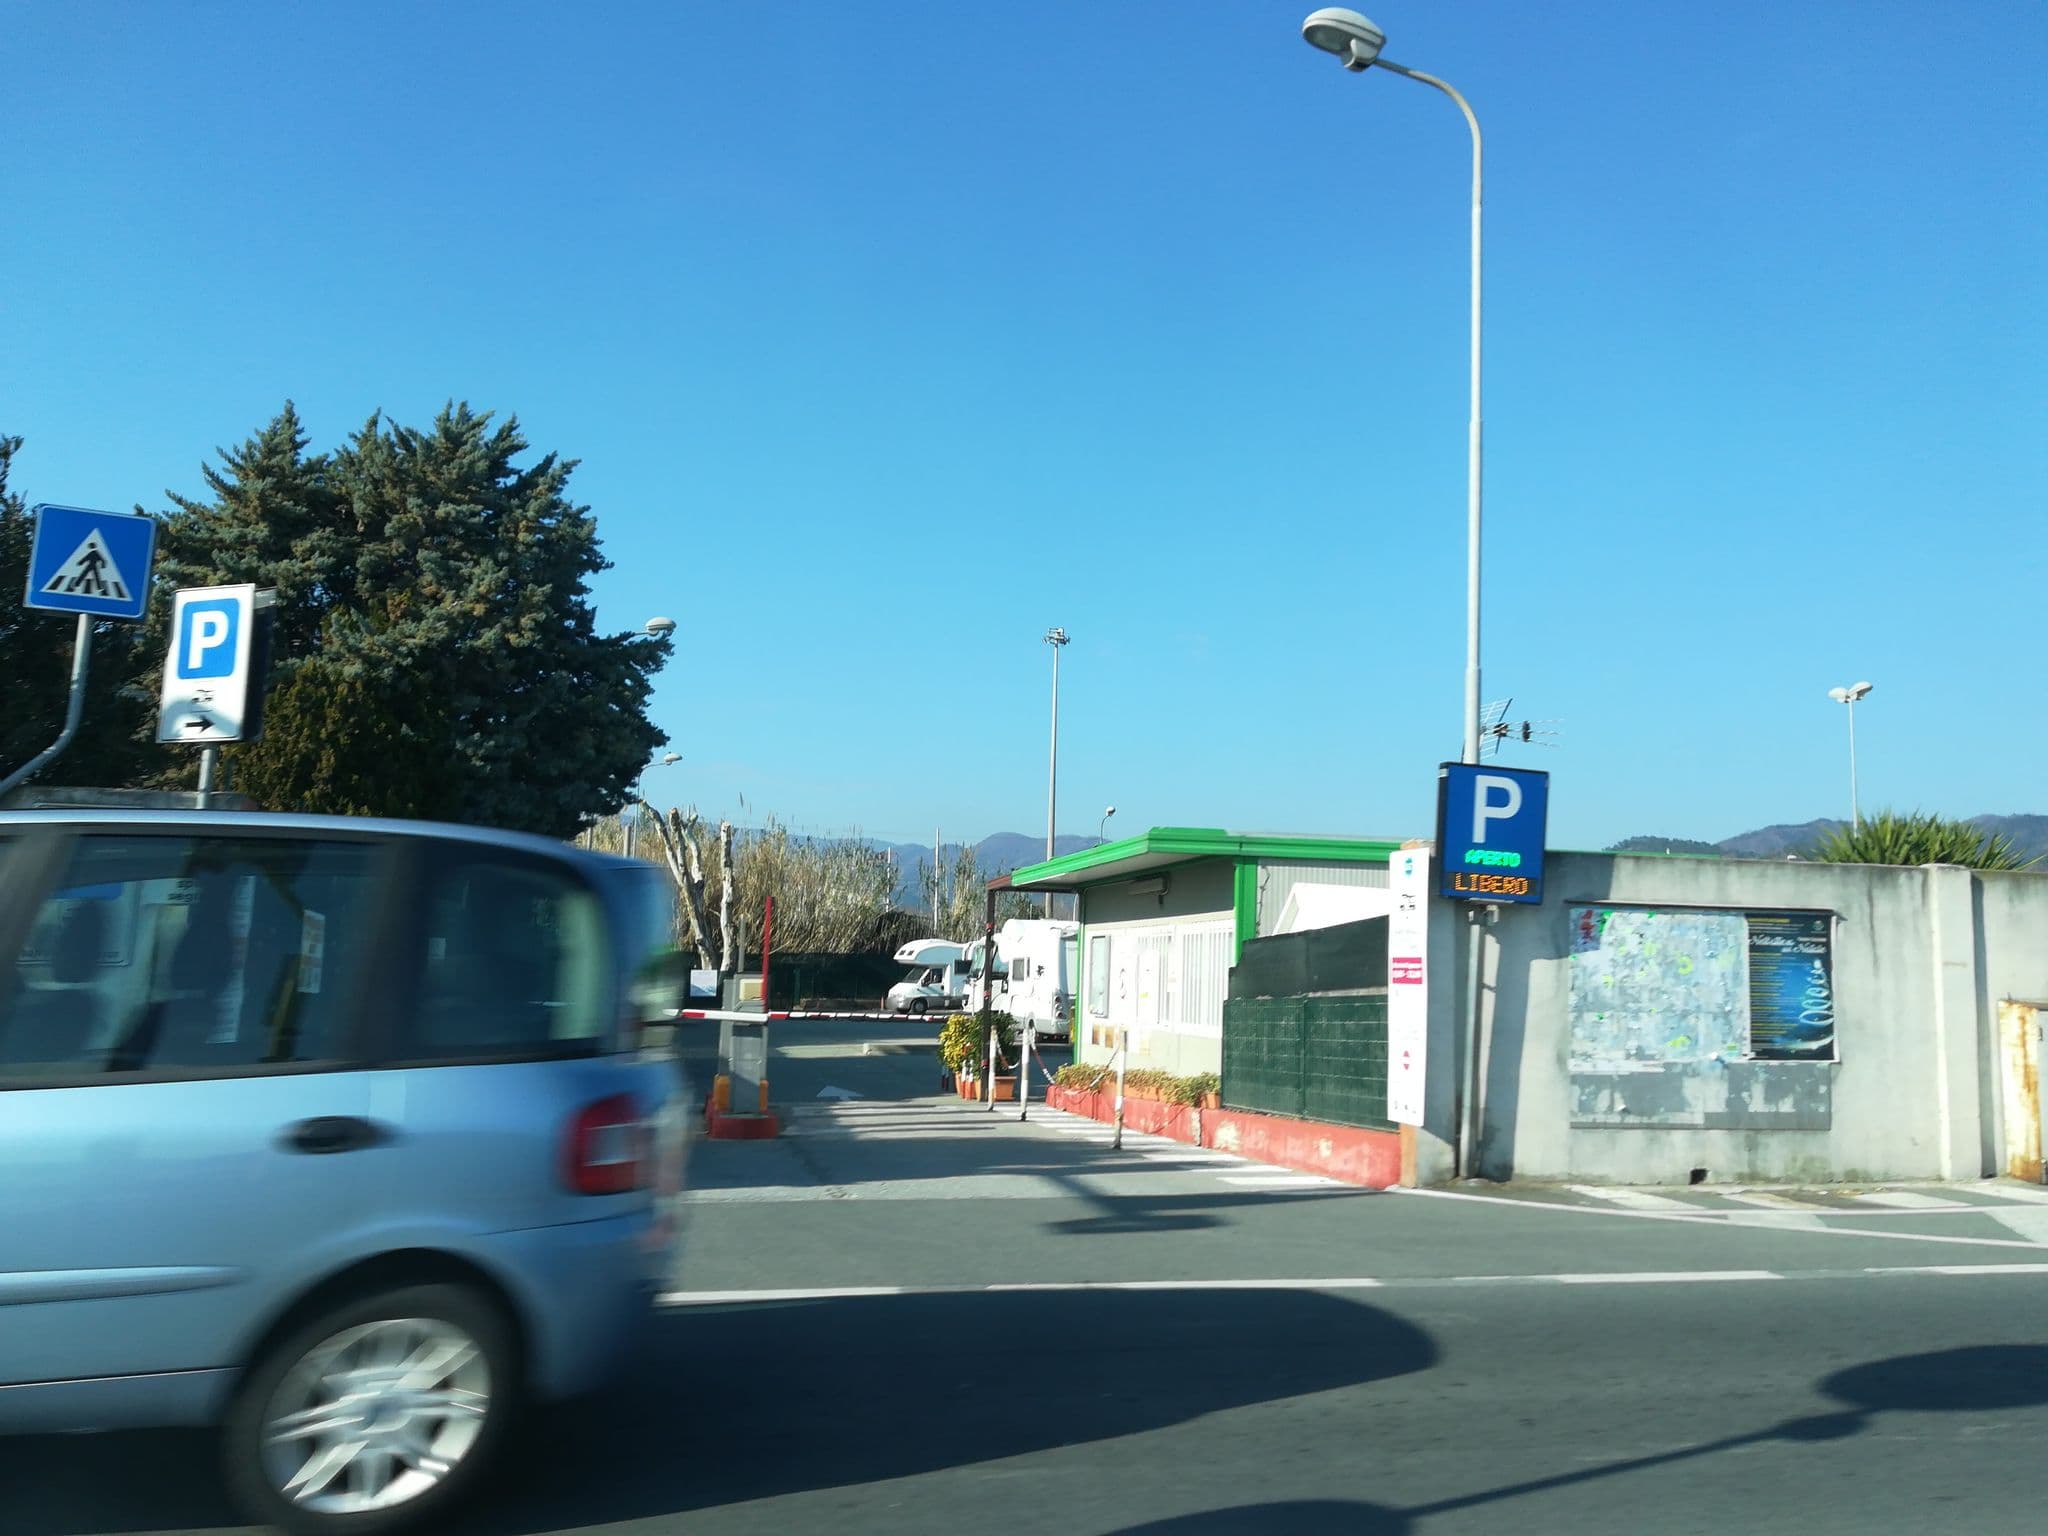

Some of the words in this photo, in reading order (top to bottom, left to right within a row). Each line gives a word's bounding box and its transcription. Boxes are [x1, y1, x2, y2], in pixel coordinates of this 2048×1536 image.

[188, 610, 229, 669] P
[1472, 774, 1522, 843] P
[1454, 872, 1529, 895] LIBERO
